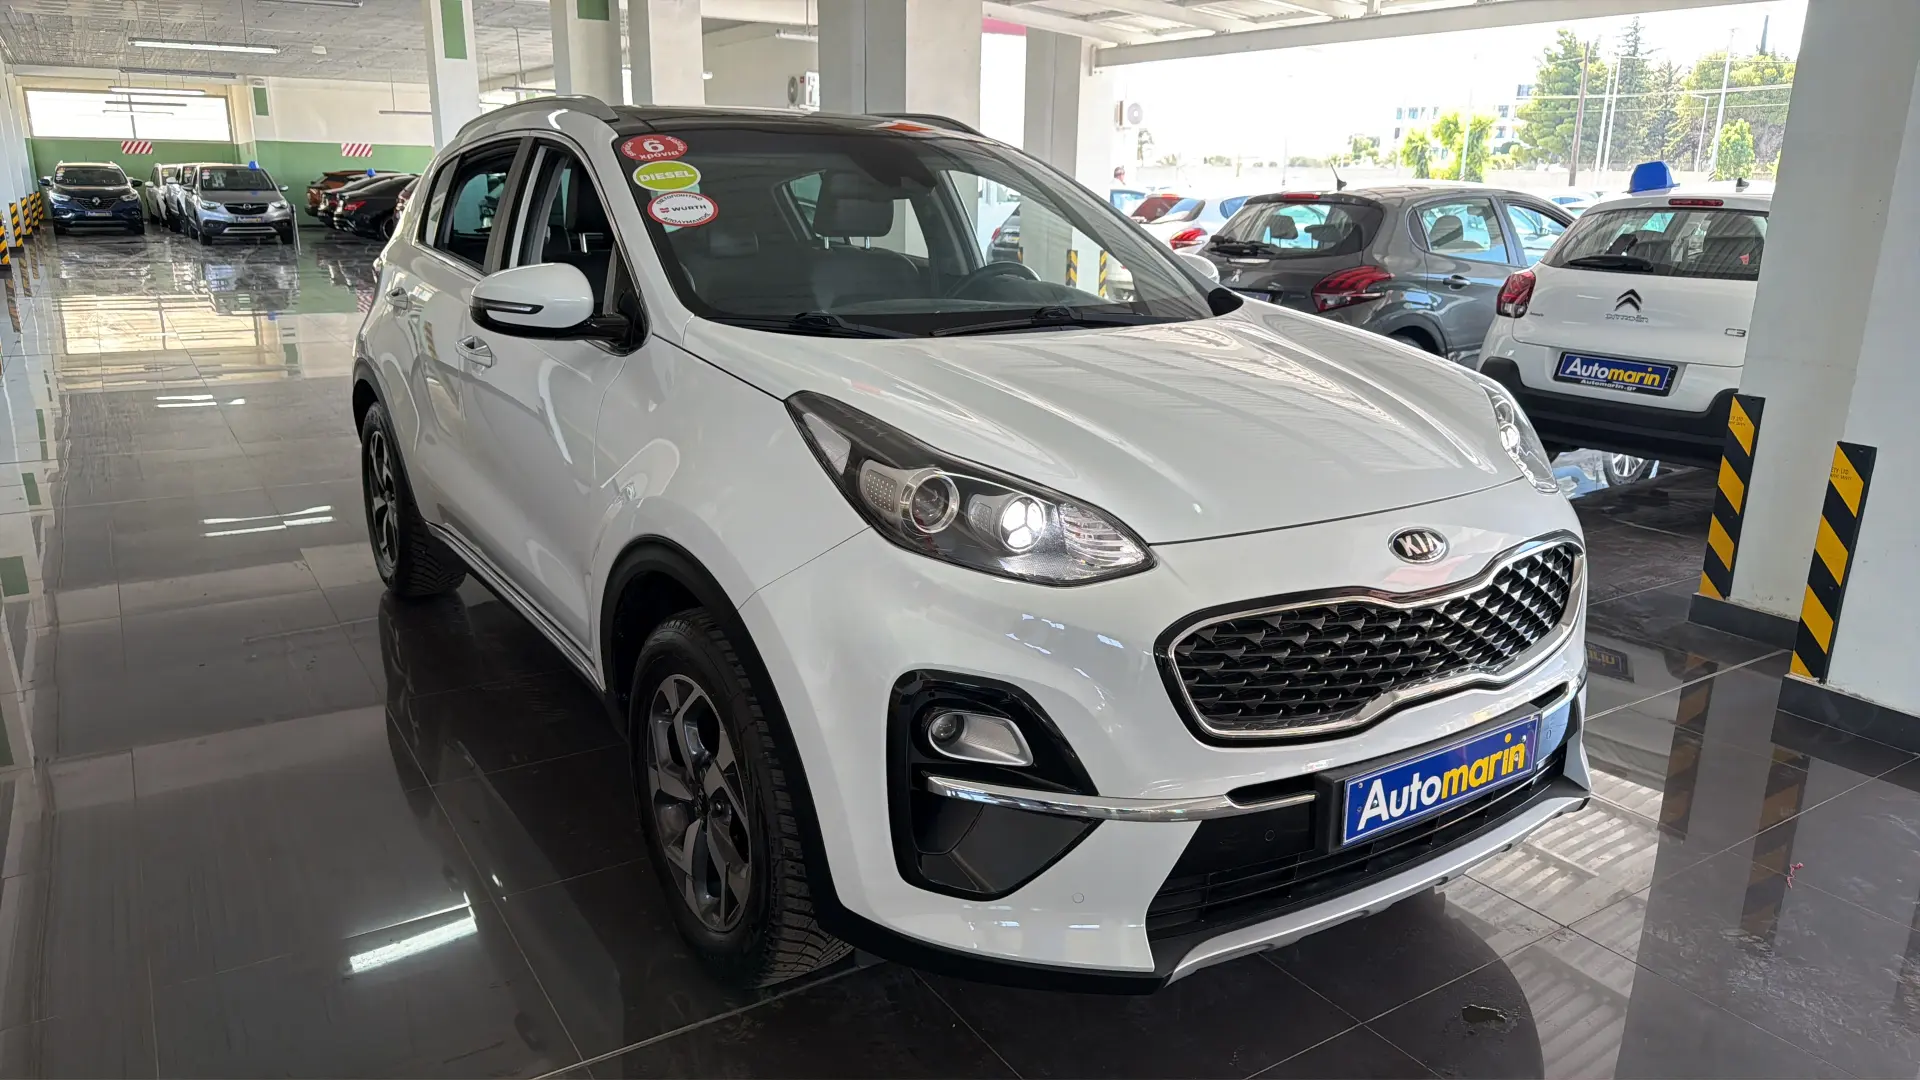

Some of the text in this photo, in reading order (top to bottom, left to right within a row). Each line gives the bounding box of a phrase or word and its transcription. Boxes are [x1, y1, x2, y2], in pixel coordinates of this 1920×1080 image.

[643, 140, 665, 152] 6
[639, 171, 693, 182] DIESEL
[1565, 357, 1660, 387] Automarin
[1580, 378, 1637, 391] Automarin.gr
[1396, 531, 1439, 557] KIA
[1357, 734, 1525, 830] Automarin
